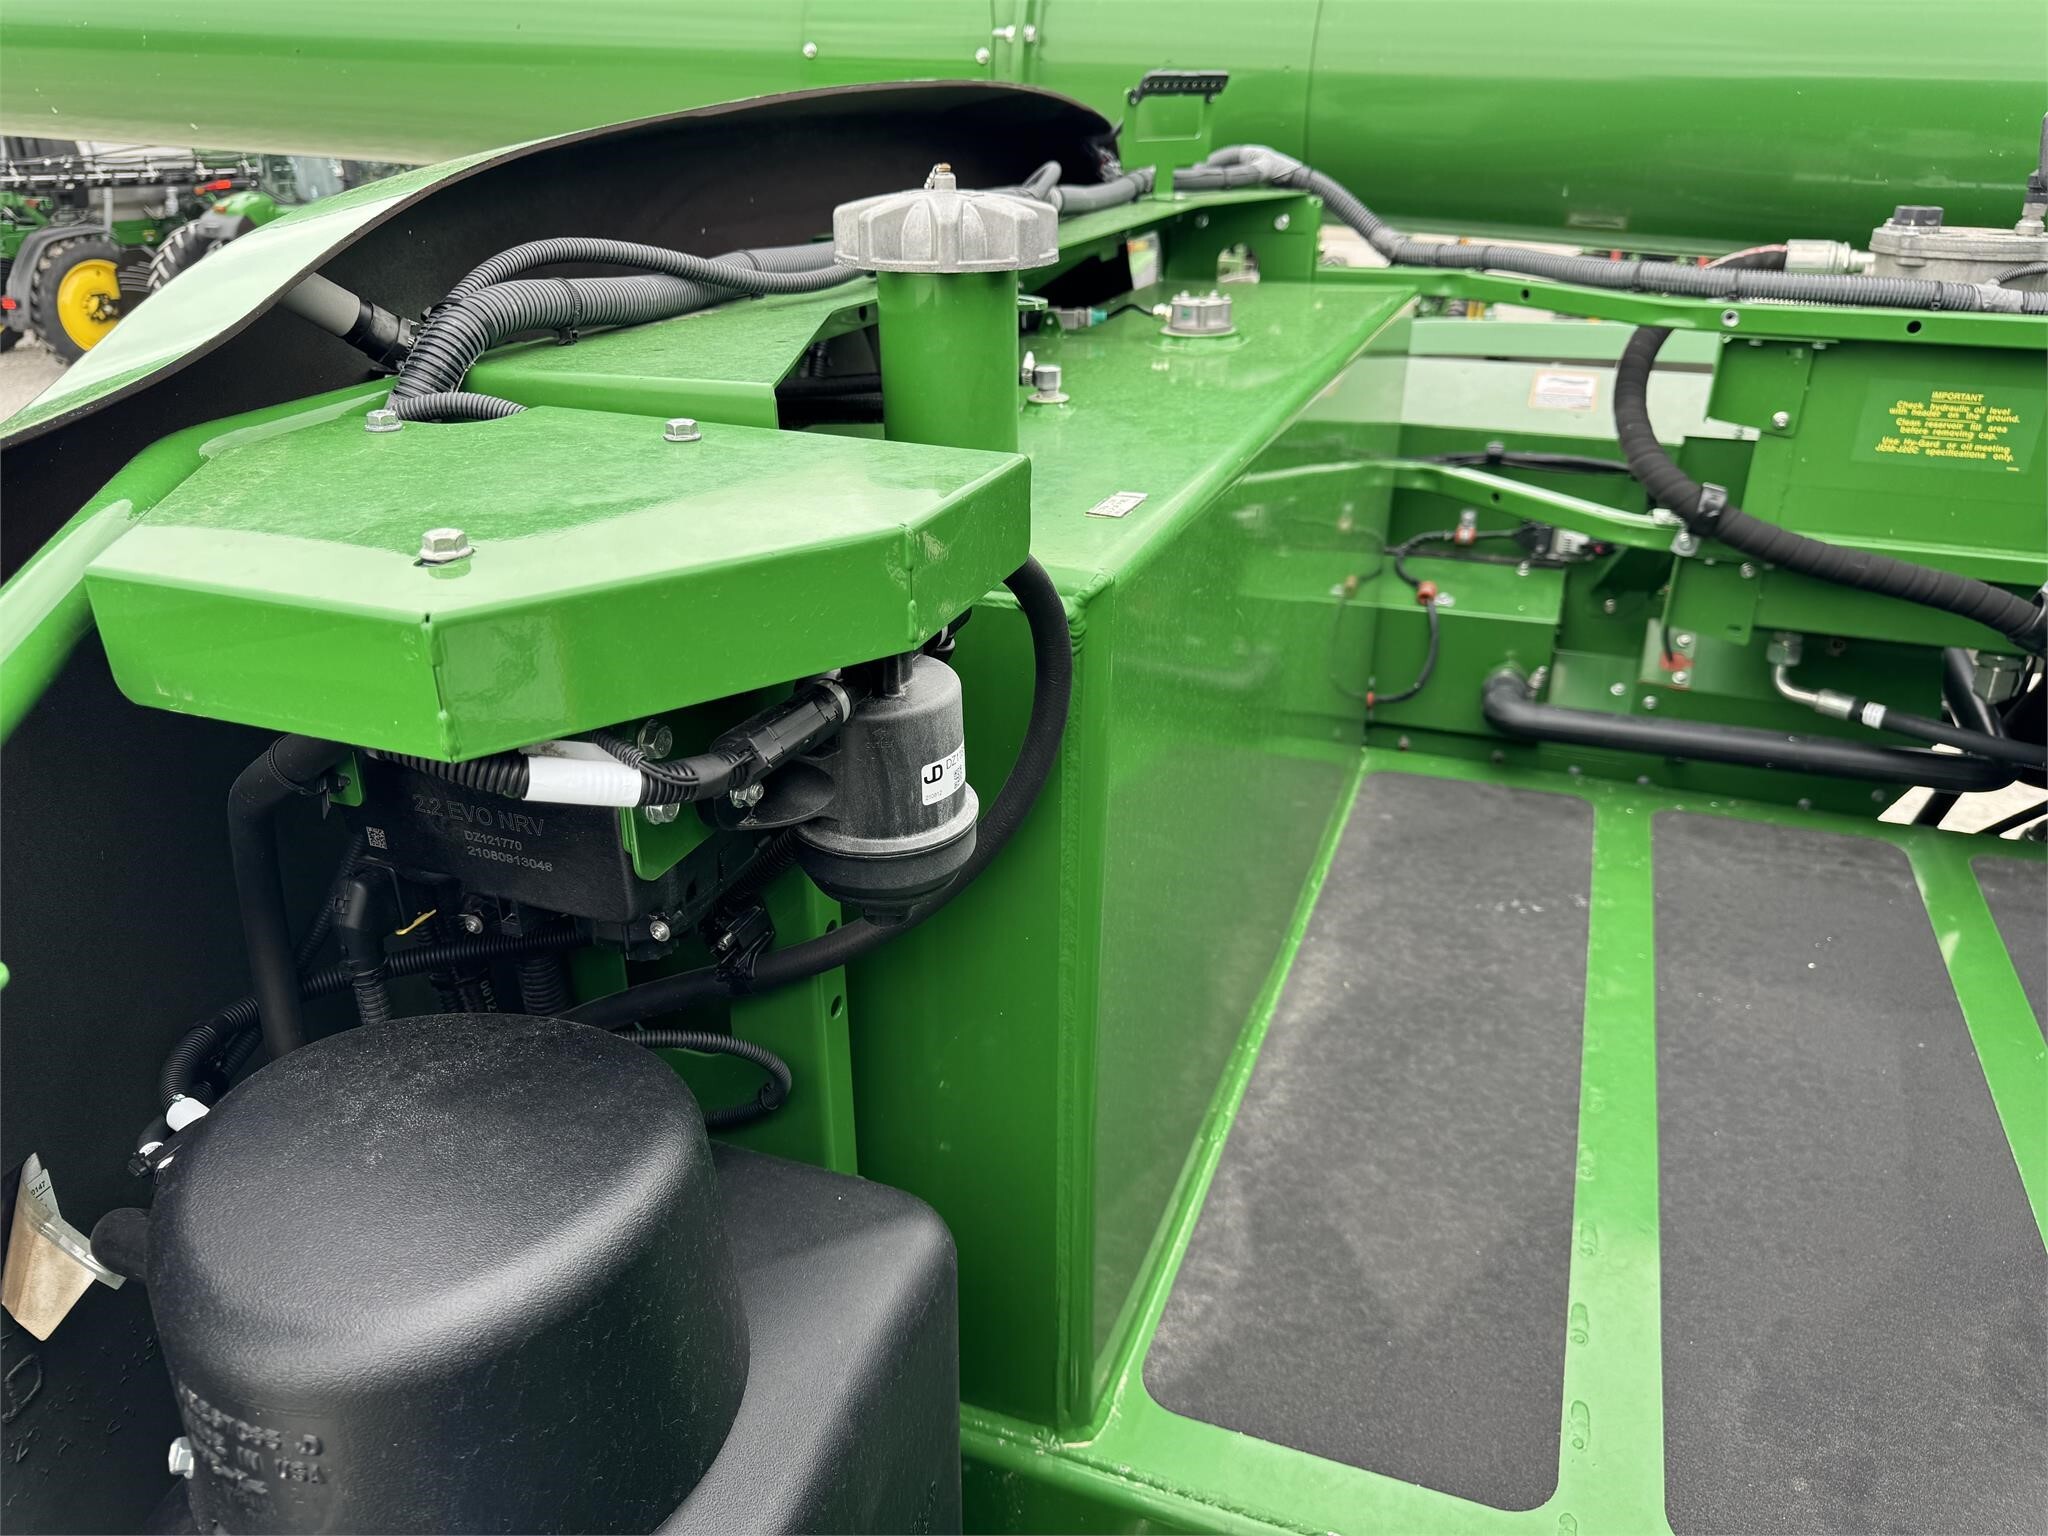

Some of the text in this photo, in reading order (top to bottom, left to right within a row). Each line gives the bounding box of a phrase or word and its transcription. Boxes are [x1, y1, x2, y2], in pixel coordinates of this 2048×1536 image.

[1931, 391, 1984, 402] IMPORTANT
[1889, 407, 1908, 416] with
[1965, 412, 1980, 420] the
[1986, 414, 2021, 424] ground.
[1896, 400, 2011, 416] Check hydraulic oil level
[1895, 417, 2008, 433] Clean reservoir fill area
[1899, 425, 1929, 435] before
[1932, 428, 1975, 440] removing
[1882, 436, 1900, 445] Use
[1946, 442, 1957, 450] or
[1960, 442, 1973, 451] oil
[1974, 443, 2011, 455] meeting
[1925, 448, 1987, 460] specifications
[924, 764, 943, 785] JD
[413, 794, 545, 837] 2.2 EVO NRV
[464, 829, 523, 851] DZ121770
